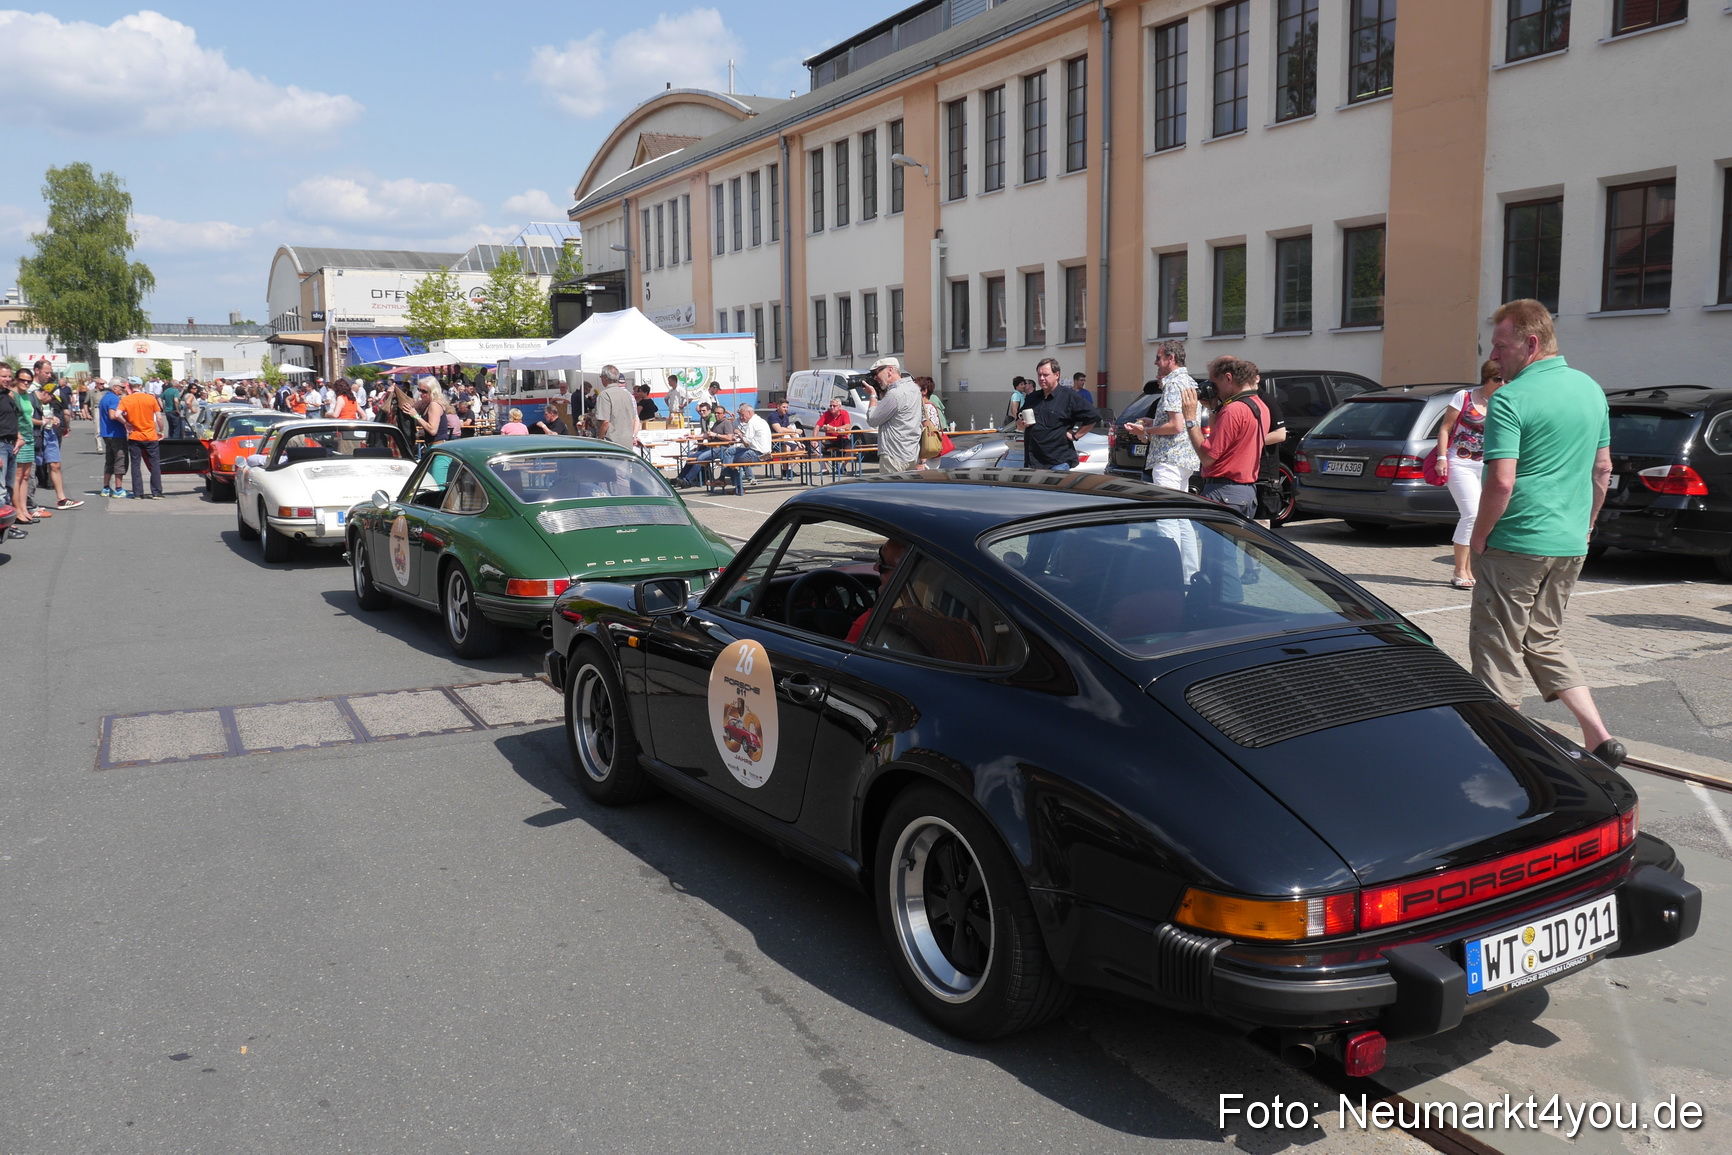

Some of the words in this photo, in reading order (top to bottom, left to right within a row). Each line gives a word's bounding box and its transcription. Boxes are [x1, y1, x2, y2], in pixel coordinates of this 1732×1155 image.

[312, 312, 324, 320] sky
[1345, 463, 1362, 472] 6308
[586, 555, 699, 567] PORSCHE
[735, 644, 756, 676] 26
[723, 676, 761, 695] PORSCHE
[736, 688, 747, 698] 911
[1402, 837, 1600, 913] PORSCHE
[1485, 934, 1519, 981] WT
[1539, 918, 1569, 963] JD
[1575, 901, 1616, 950] 911
[1471, 972, 1479, 984] D
[1511, 973, 1538, 989] PORSCHE
[1538, 965, 1563, 980] ZENTRUM
